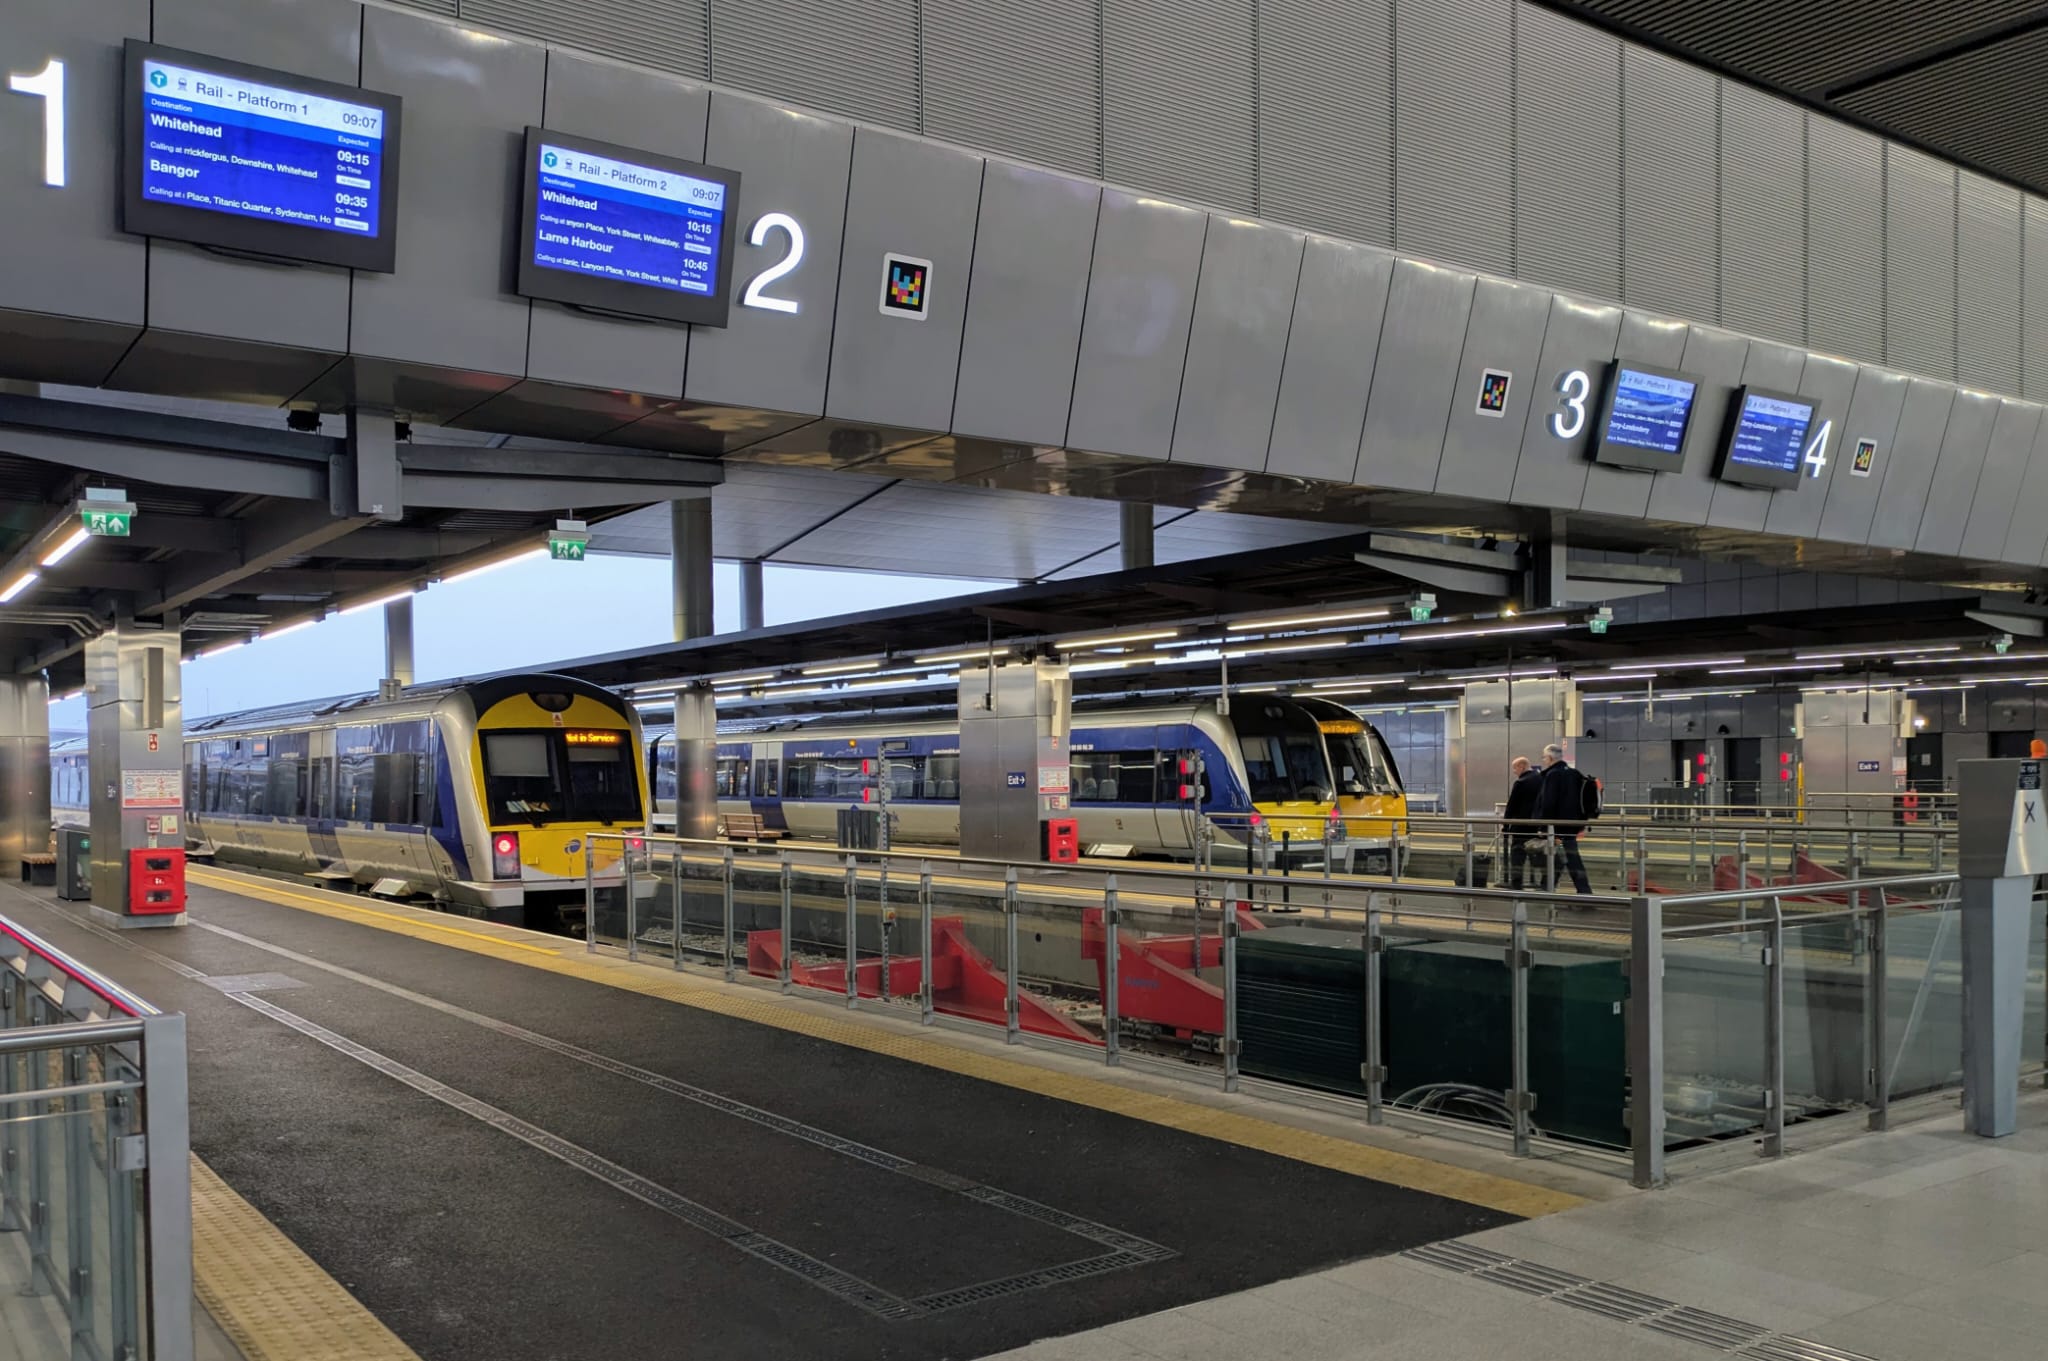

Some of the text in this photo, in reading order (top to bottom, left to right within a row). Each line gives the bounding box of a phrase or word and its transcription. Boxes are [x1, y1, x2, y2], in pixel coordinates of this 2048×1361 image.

[151, 98, 193, 112] Destination
[196, 82, 223, 98] Rail
[238, 91, 298, 114] Platform
[302, 104, 308, 116] 1
[10, 59, 65, 187] 1
[150, 113, 222, 138] Whitehead
[343, 113, 377, 129] 09:07
[338, 135, 369, 147] Expected
[150, 141, 174, 153] Calling
[231, 155, 275, 171] Downshire,
[276, 164, 318, 179] Whitehead
[337, 150, 370, 166] 09:15
[150, 159, 200, 178] Bangor
[336, 164, 362, 175] On Time
[579, 162, 600, 176] Rail
[611, 169, 658, 188] Platform
[660, 180, 667, 191] 2
[335, 192, 368, 208] 09:35
[542, 190, 598, 211] Whitehead
[692, 188, 720, 202] 09:07
[149, 186, 173, 198] Calling
[186, 192, 211, 205] Place,
[213, 195, 240, 210] Titanic
[241, 200, 274, 215] Quarter,
[275, 207, 318, 223] Sydenham,
[345, 208, 360, 218] Time
[686, 221, 712, 234] 10:15
[539, 229, 614, 253] Larne Harbour
[683, 258, 708, 272] 10:45
[743, 212, 805, 314] 2
[1553, 370, 1590, 439] 3
[1805, 420, 1832, 478] 4
[588, 733, 617, 743] Service
[1007, 775, 1019, 785] Exit
